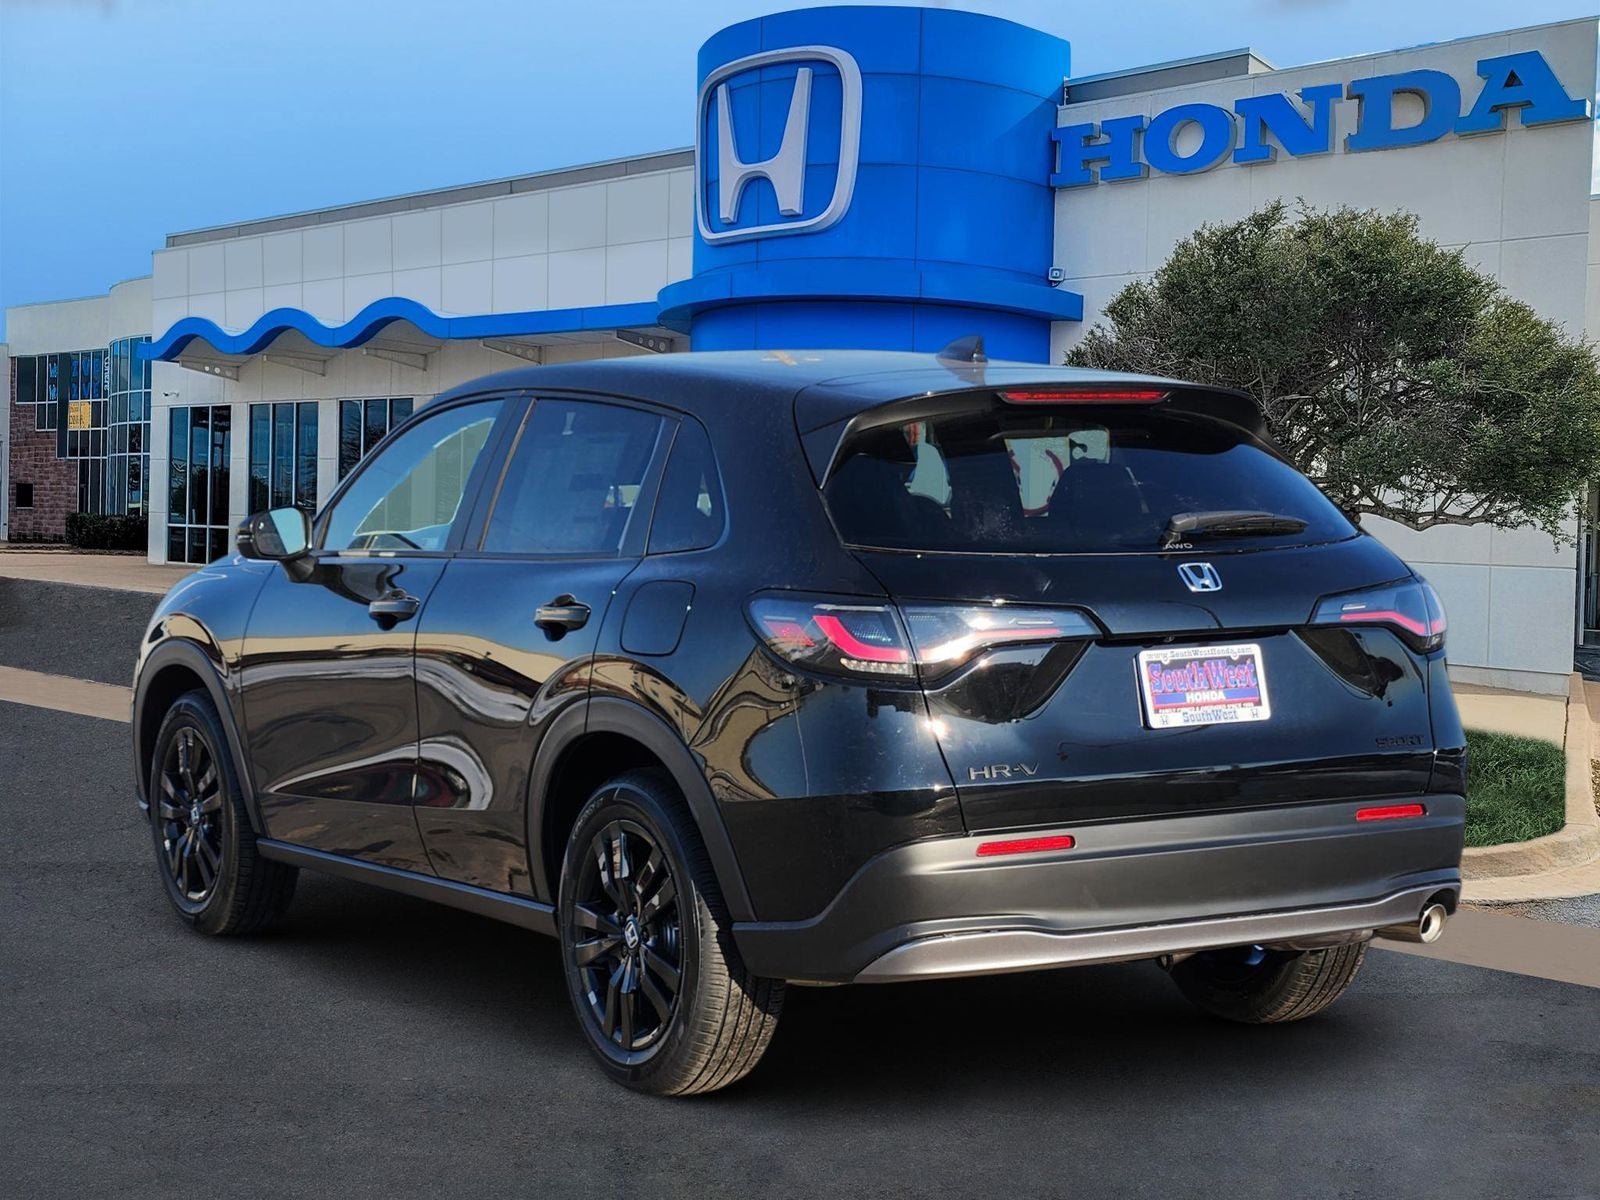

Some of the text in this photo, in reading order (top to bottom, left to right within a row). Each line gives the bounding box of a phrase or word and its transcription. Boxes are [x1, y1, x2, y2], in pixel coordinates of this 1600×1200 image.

[1050, 50, 1591, 188] HONDA
[1186, 690, 1226, 703] HONDA
[1182, 710, 1239, 723] SouthWest
[968, 762, 1040, 780] HR-V
